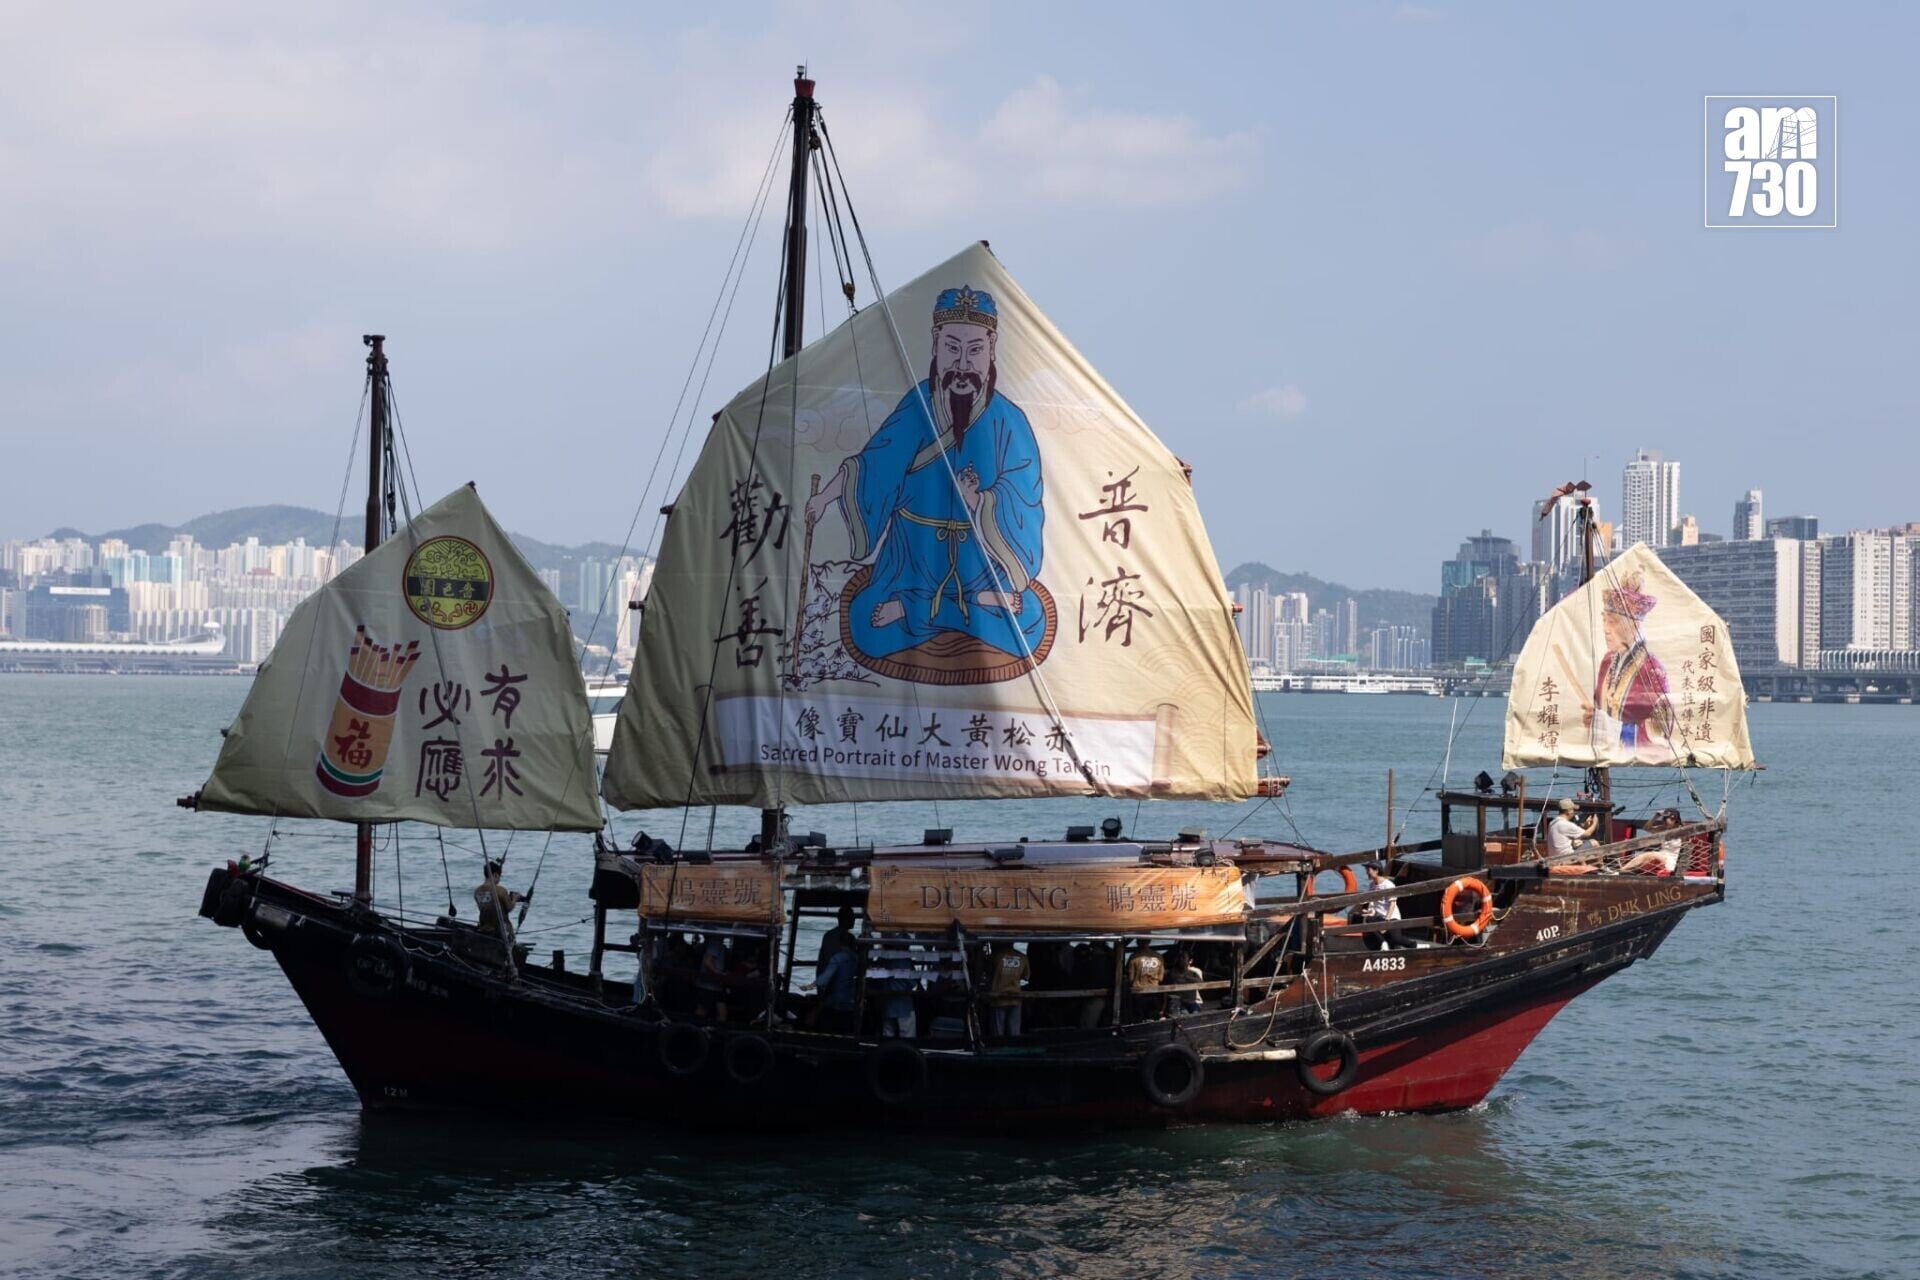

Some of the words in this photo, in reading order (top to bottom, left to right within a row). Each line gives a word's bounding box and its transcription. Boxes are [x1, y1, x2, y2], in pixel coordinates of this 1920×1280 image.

[714, 474, 792, 669] 勸善
[1078, 465, 1153, 647] 普濟
[1695, 624, 1718, 743] 國家級非遺
[334, 718, 373, 769] 福
[415, 680, 471, 802] 必應
[480, 664, 528, 799] 有求
[760, 744, 818, 762] Sacred
[823, 747, 896, 766] Portrait
[901, 750, 920, 767] of
[926, 751, 989, 770] Master
[994, 755, 1047, 777] Wong
[1052, 757, 1077, 773] Tai
[1083, 760, 1111, 776] Sin
[920, 885, 1069, 911] DUKLING
[1106, 882, 1197, 912] 鴨靈號
[1607, 898, 1641, 920] DUK
[1646, 886, 1681, 909] LING
[1362, 957, 1406, 972] A4833
